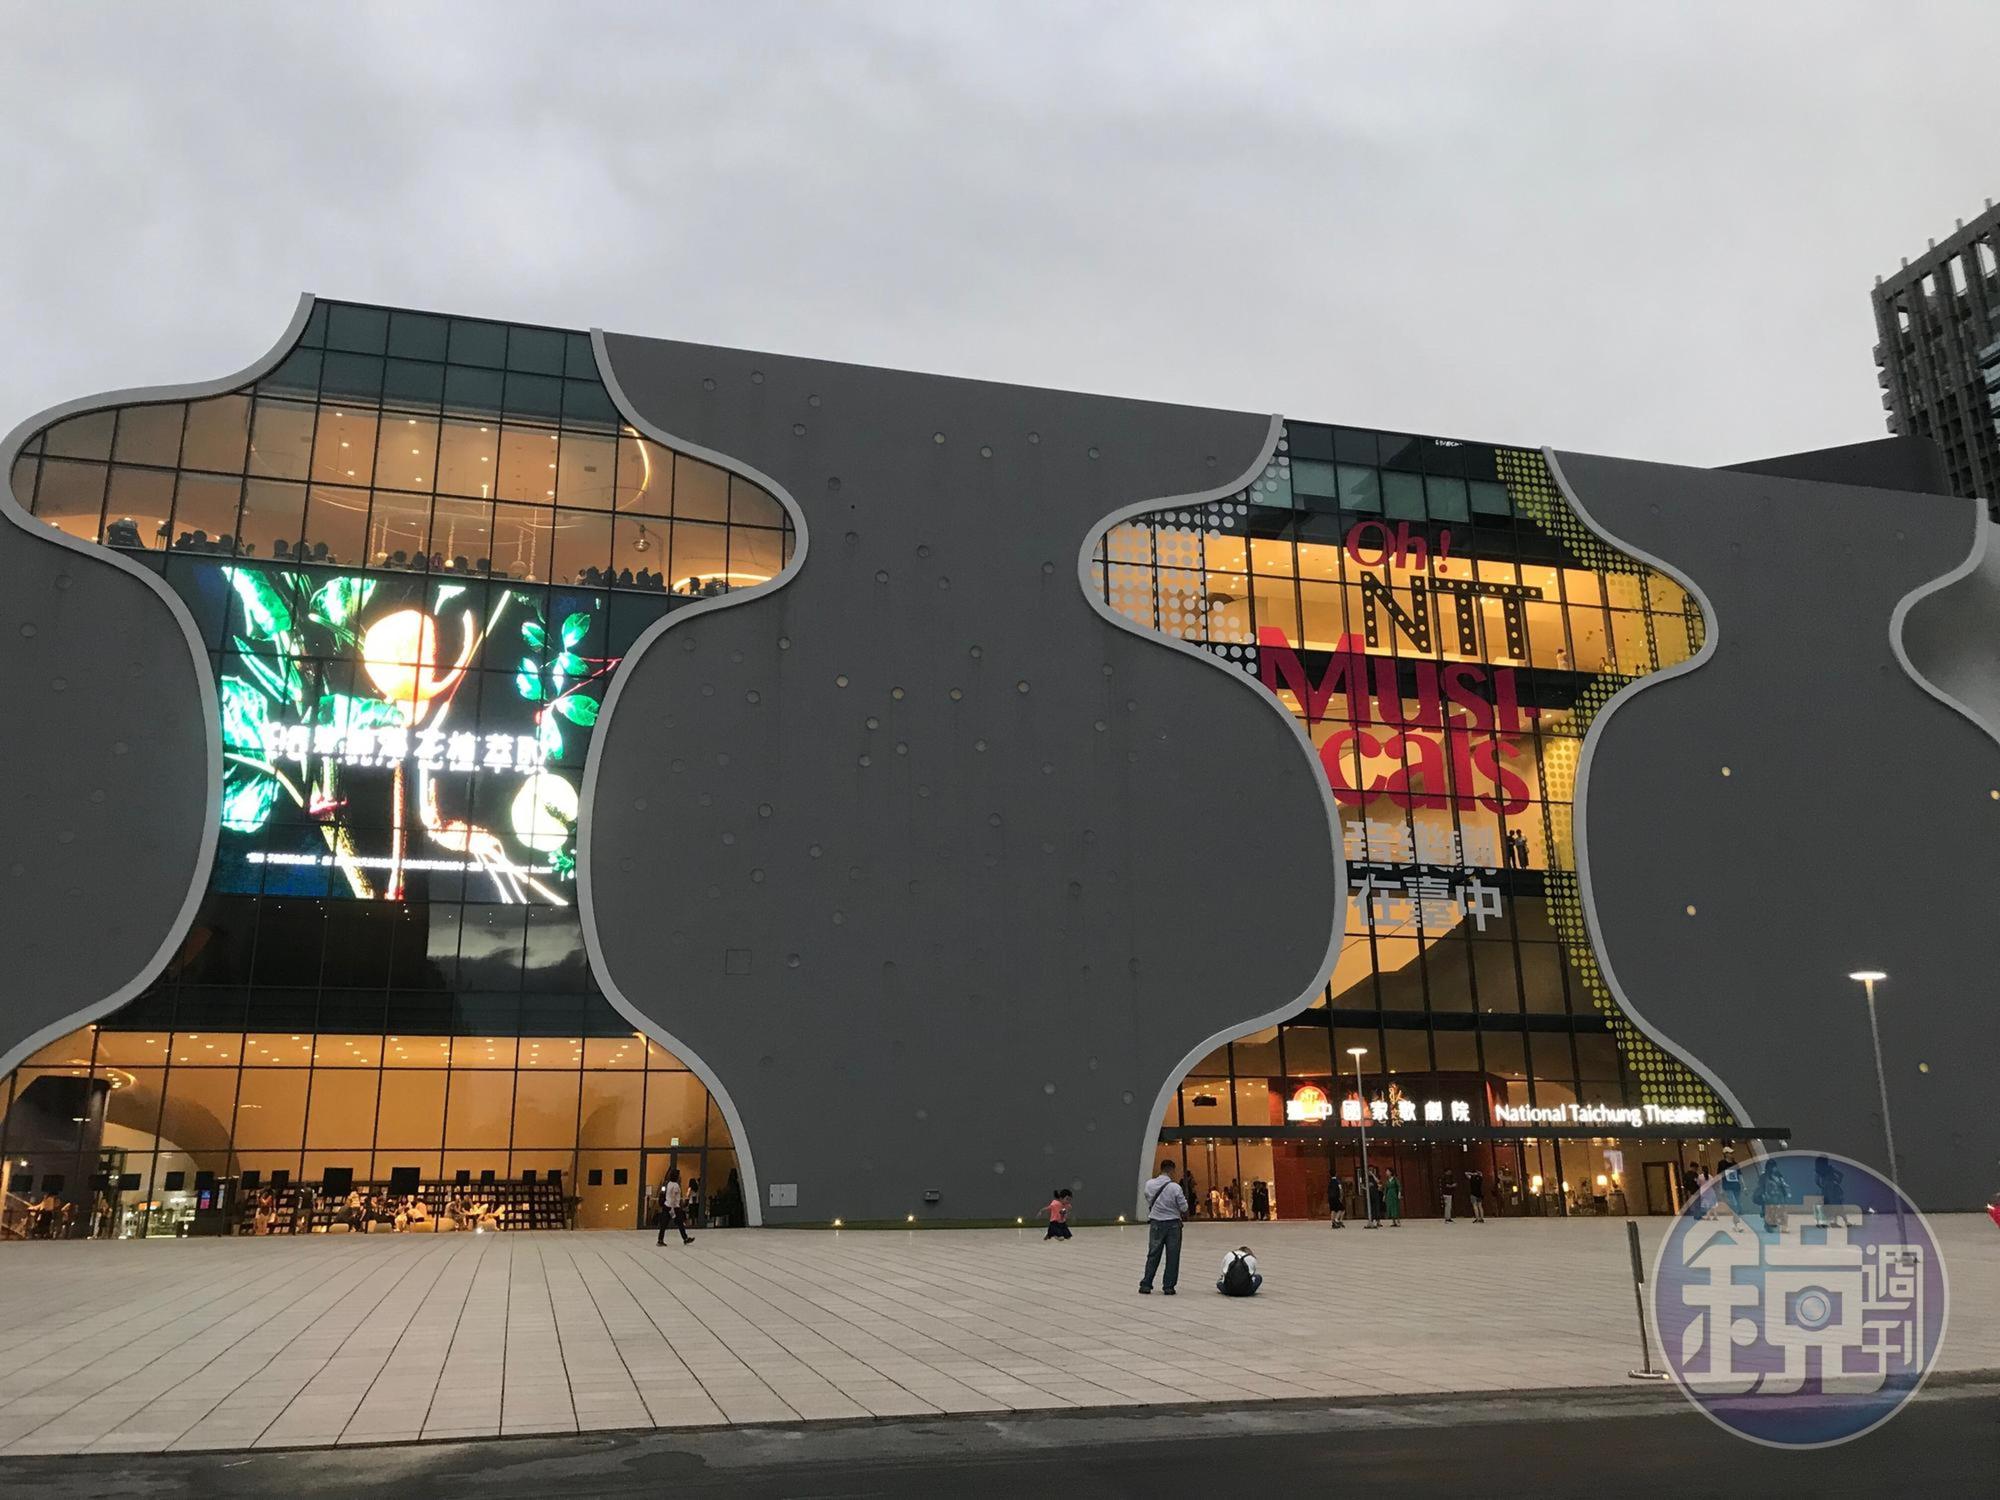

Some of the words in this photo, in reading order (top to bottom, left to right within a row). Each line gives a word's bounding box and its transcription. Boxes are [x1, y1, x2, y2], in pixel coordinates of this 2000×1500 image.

[1346, 520, 1453, 574] Oh!
[1360, 570, 1543, 660] NTT
[1318, 729, 1530, 815] cals
[1344, 817, 1498, 876] 音樂劇
[1350, 873, 1503, 932] 在臺中
[1495, 1103, 1566, 1122] National
[1569, 1104, 1643, 1127] Taichung
[1643, 1104, 1706, 1123] Theater
